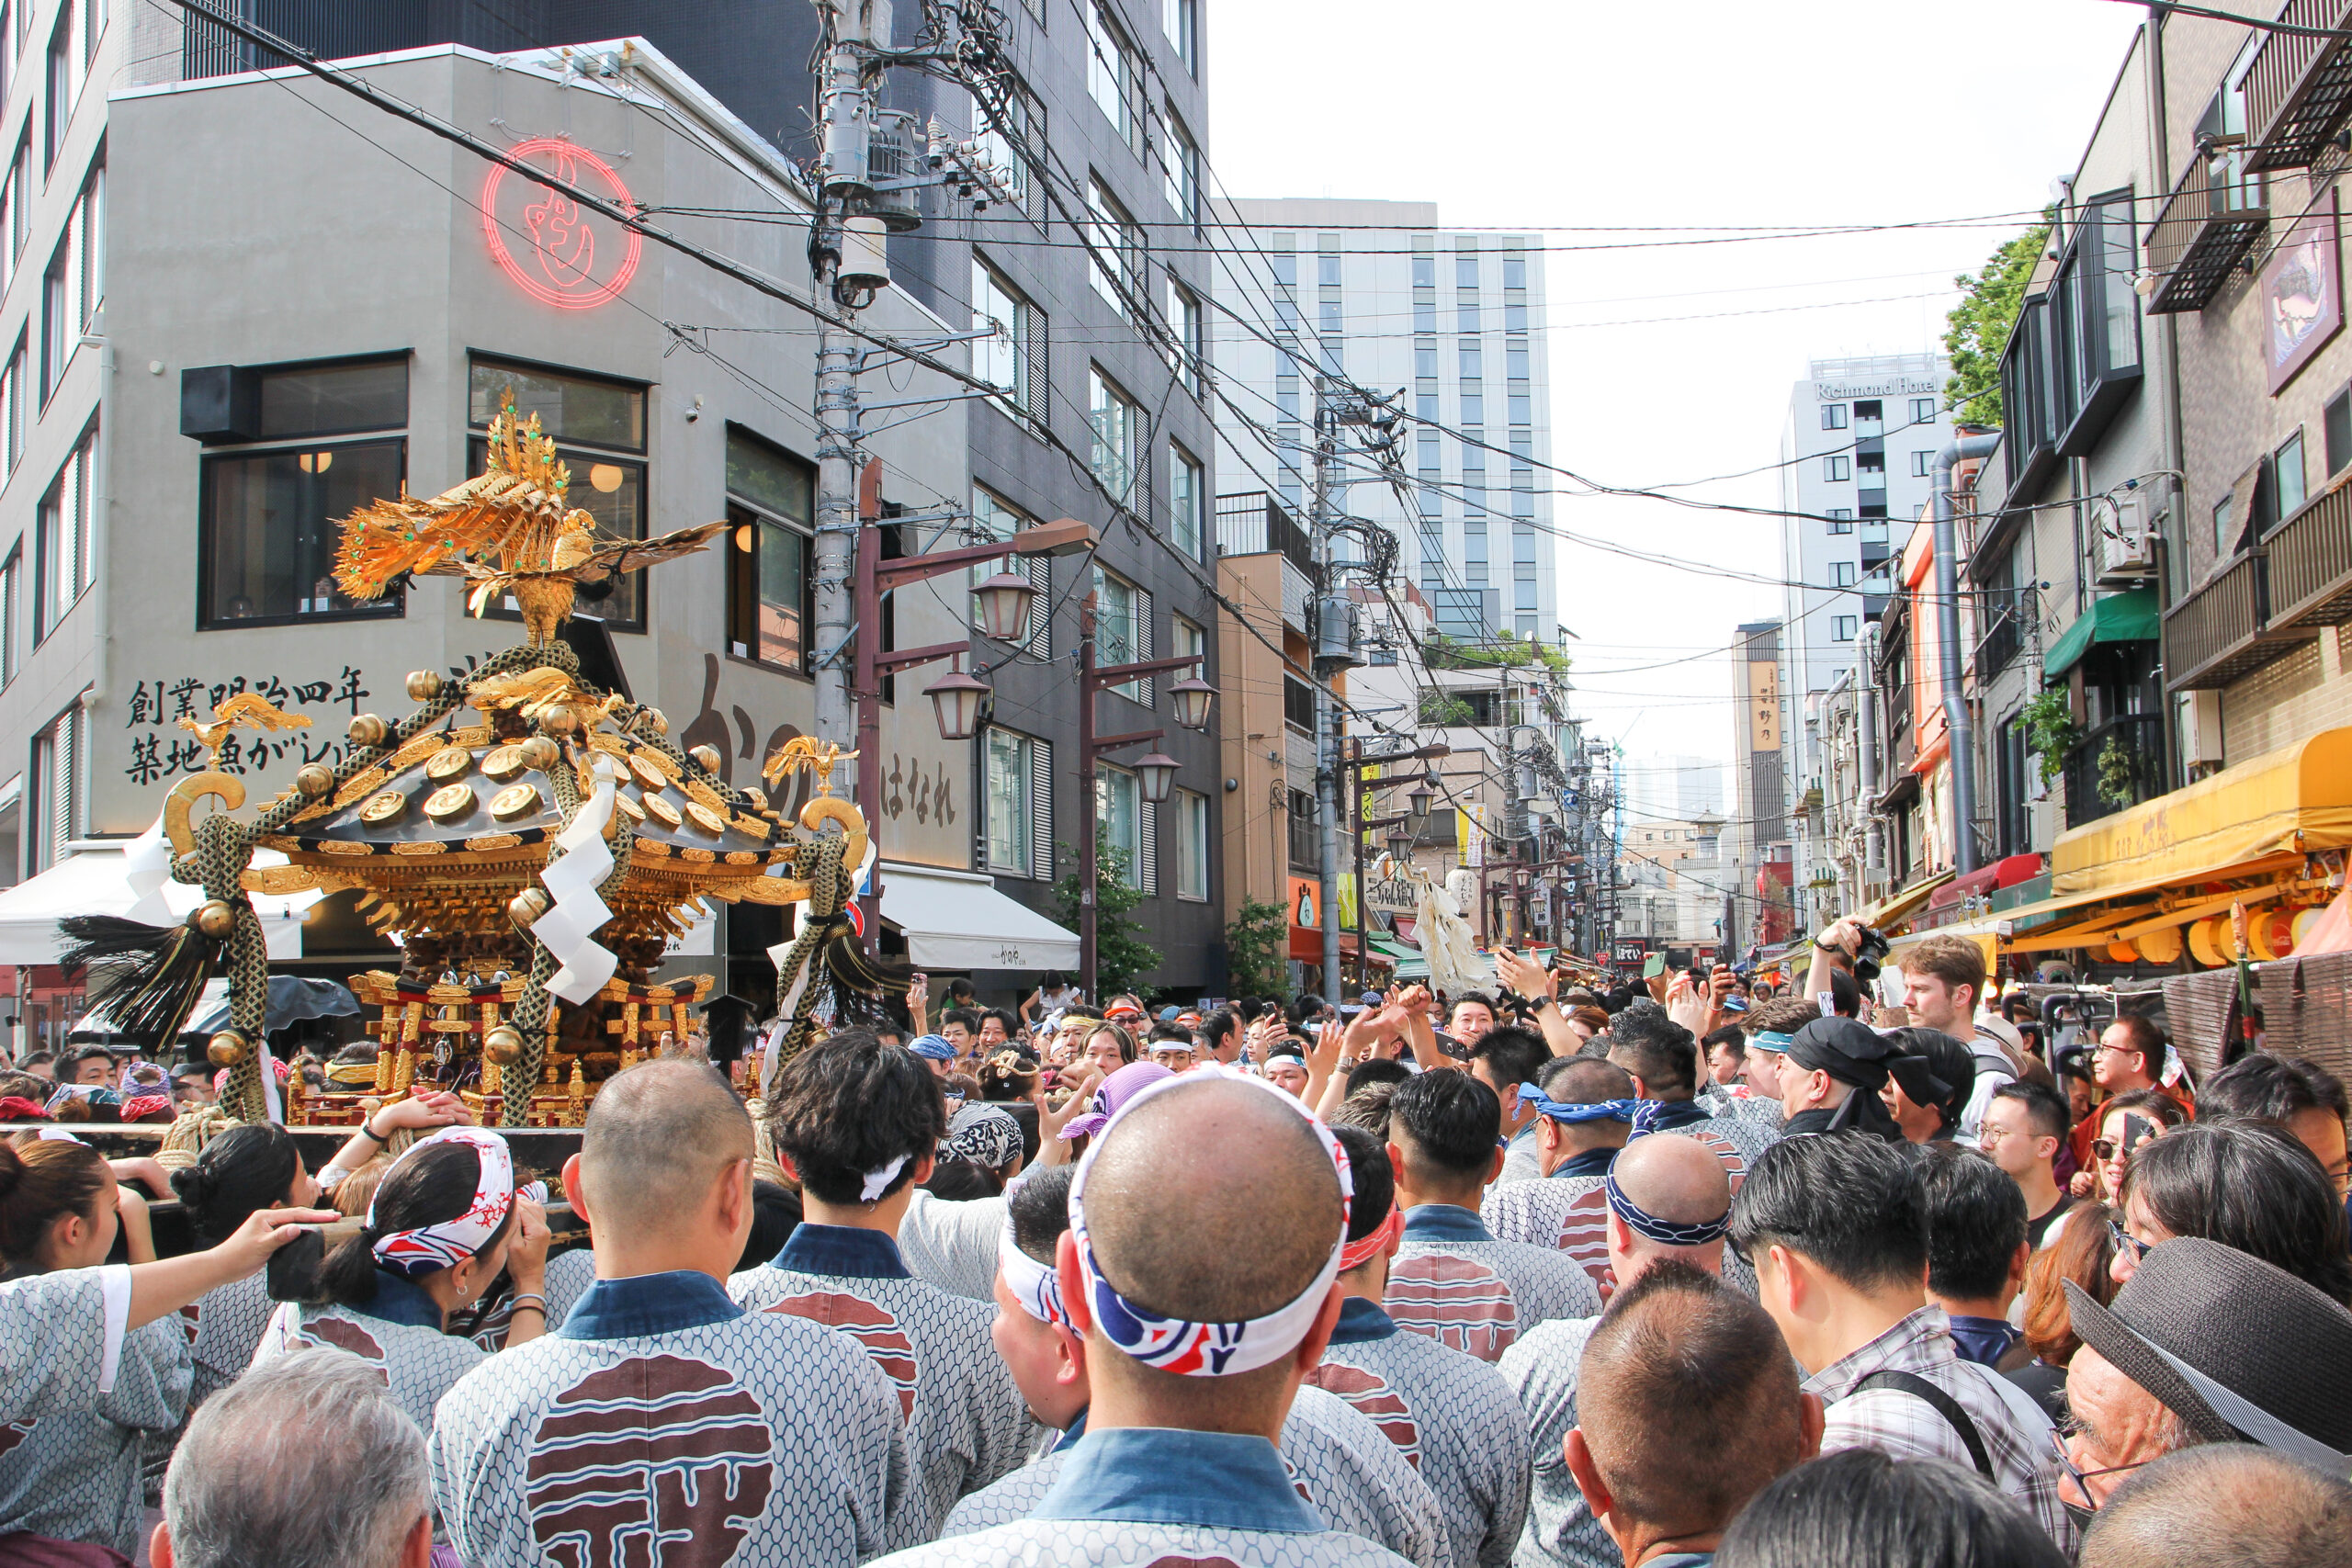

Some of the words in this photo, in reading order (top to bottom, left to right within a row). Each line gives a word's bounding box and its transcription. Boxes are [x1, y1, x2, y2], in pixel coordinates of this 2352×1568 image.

[1815, 378, 1894, 400] Richmond
[1896, 376, 1938, 396] Hotel
[881, 752, 956, 829] はなれ
